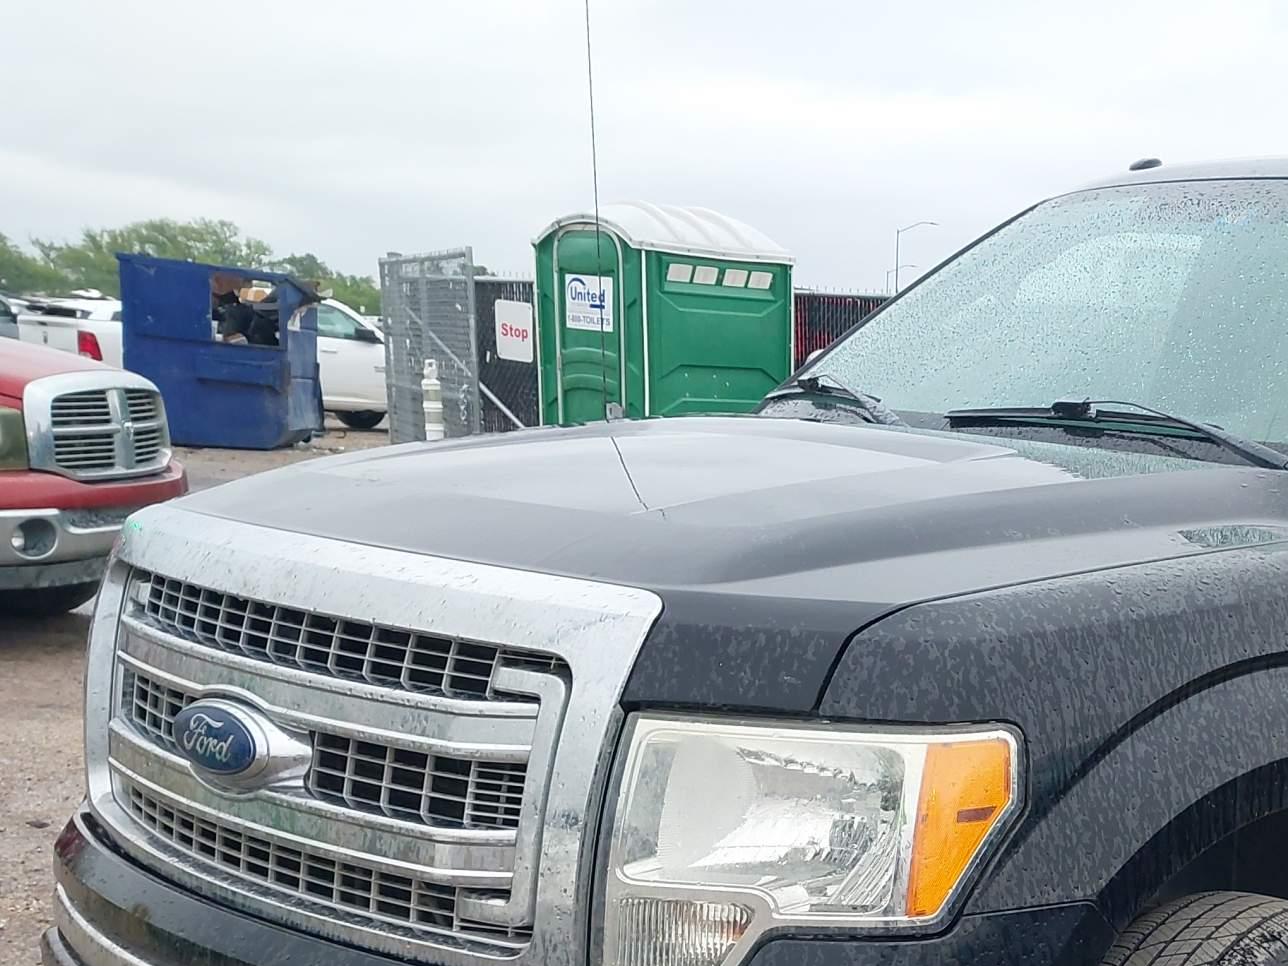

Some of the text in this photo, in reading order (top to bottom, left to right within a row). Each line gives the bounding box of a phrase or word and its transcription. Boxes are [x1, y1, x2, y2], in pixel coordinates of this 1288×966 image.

[570, 286, 606, 304] United
[568, 315, 611, 327] 1--TOILES
[501, 323, 529, 342] Stop
[183, 713, 234, 763] Ford
